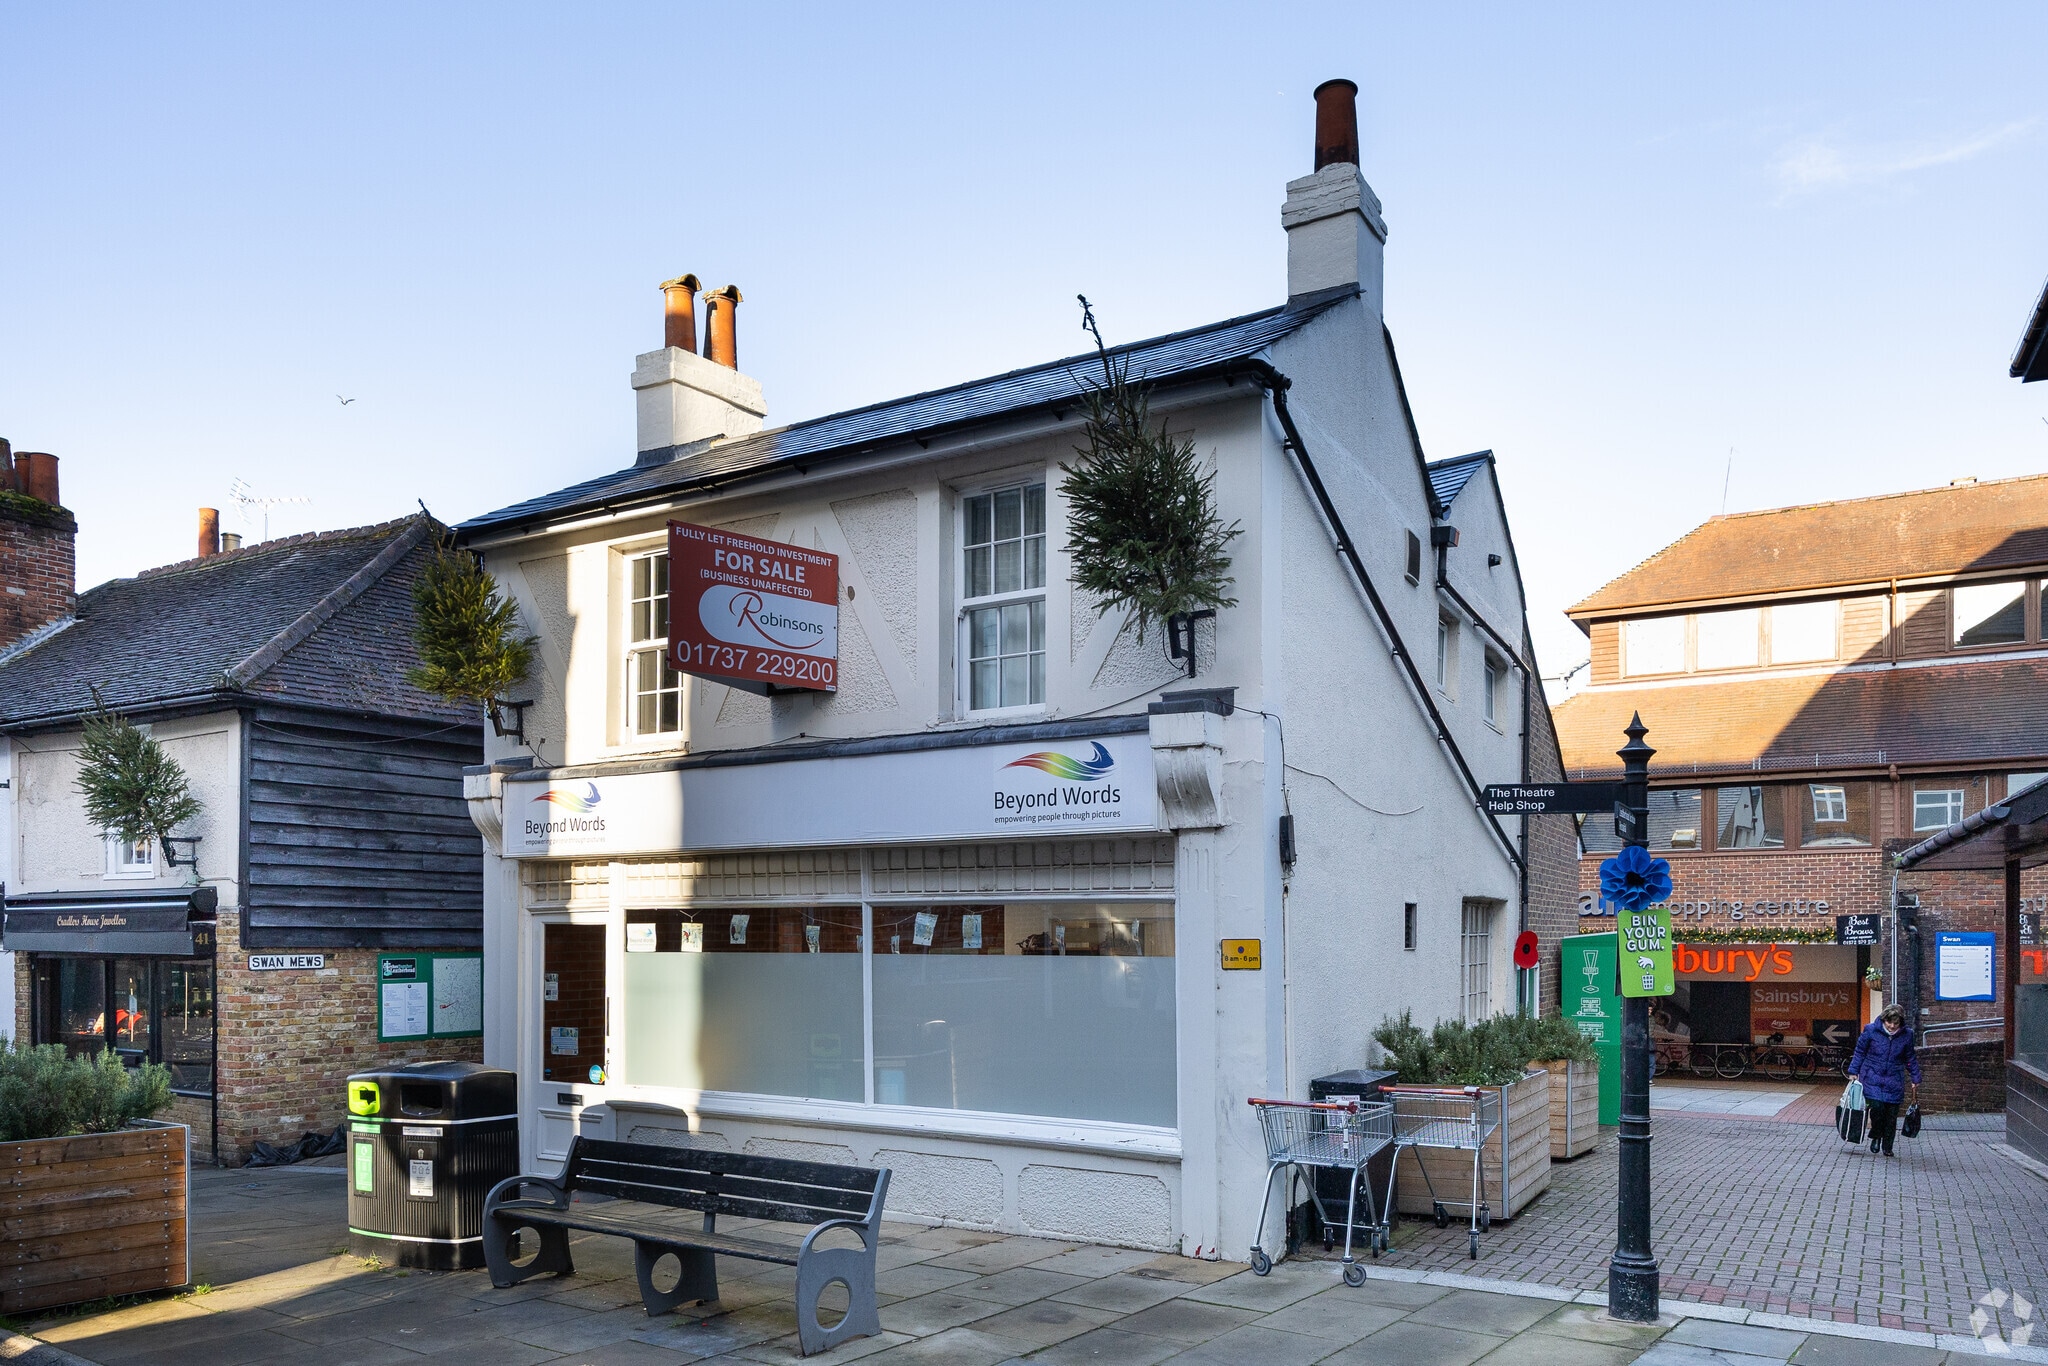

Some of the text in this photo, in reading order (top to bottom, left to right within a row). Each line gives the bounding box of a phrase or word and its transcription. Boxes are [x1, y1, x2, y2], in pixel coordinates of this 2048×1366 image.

[676, 526, 833, 568] FULLY LET FREEHOLD INVESTMENT
[714, 549, 806, 584] FOR SALE
[700, 568, 813, 600] (BUSINESS UNAFFECTED)
[728, 591, 825, 649] Robinsons
[677, 640, 834, 683] 01737 229200
[994, 784, 1121, 814] Beyond Words
[1489, 787, 1555, 798] The Theatre
[1488, 800, 1546, 812] Help Shop
[994, 810, 1121, 824] empowering people through pictures
[525, 816, 606, 838] Beyond Words
[1752, 898, 1830, 916] centre
[1632, 914, 1657, 927] BIN
[1848, 916, 1870, 926] Best
[194, 932, 209, 945] 41
[1624, 926, 1666, 940] YOUR
[1626, 938, 1665, 951] GUM.
[252, 956, 322, 968] SWAN MEWS
[1672, 944, 1794, 982] bury's
[1754, 988, 1849, 1006] Sainsbury's
